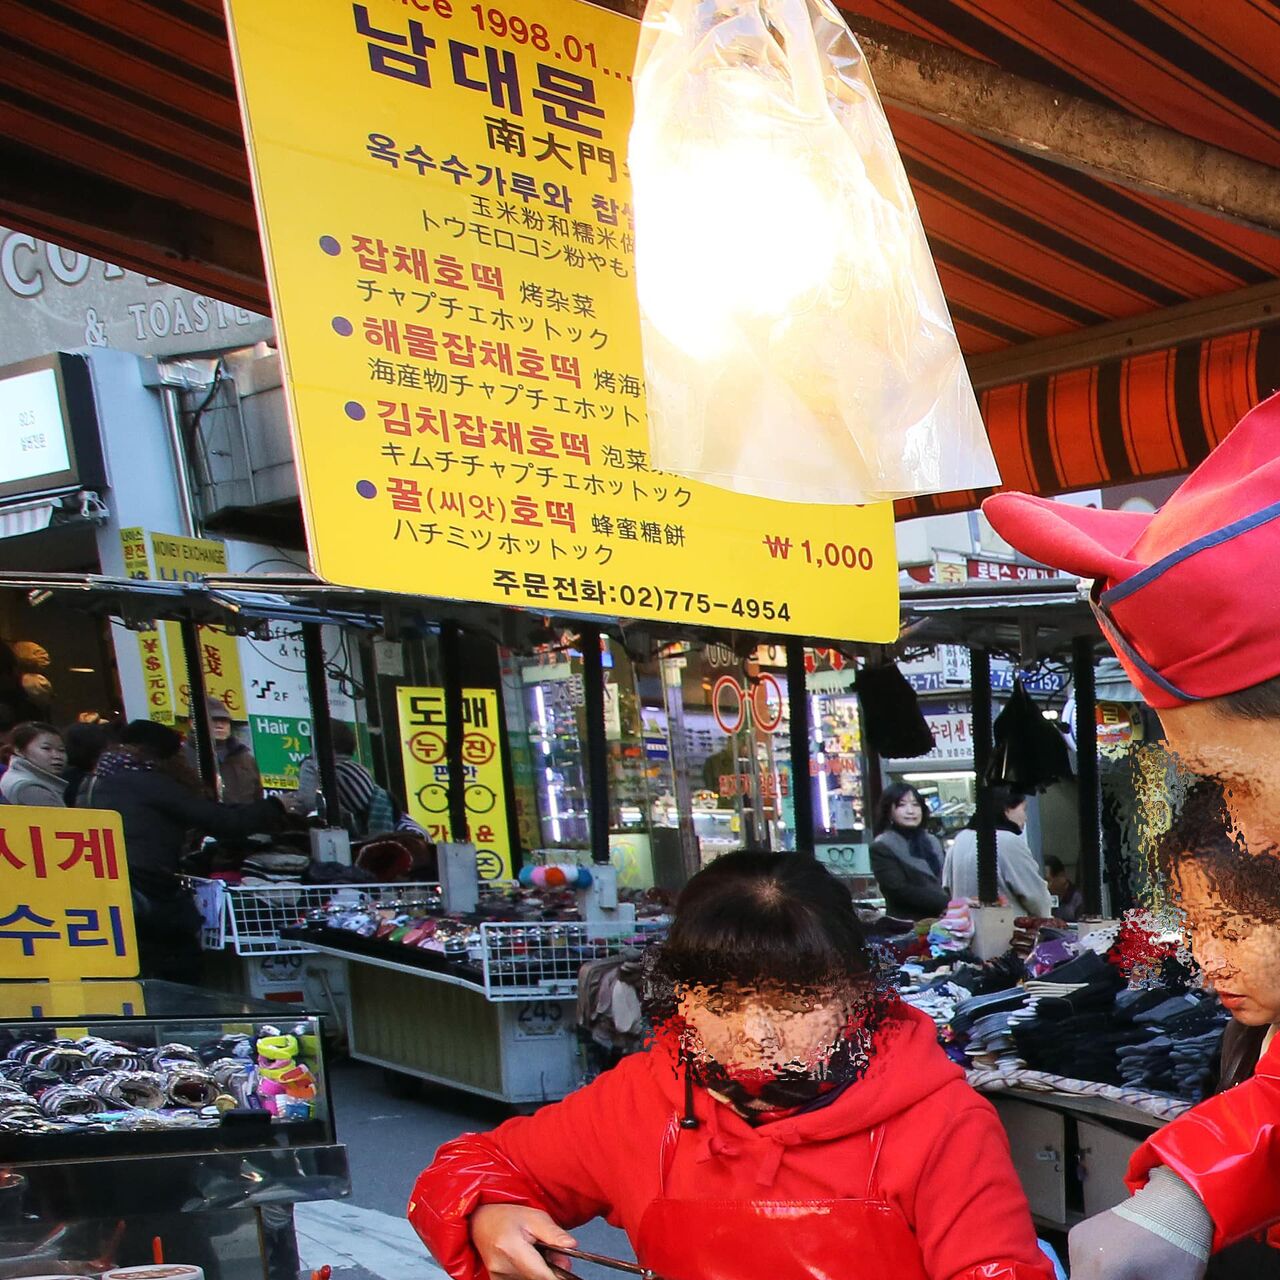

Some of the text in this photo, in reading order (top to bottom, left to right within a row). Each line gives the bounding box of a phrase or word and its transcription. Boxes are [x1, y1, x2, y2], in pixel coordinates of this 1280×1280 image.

[351, 3, 606, 140] 남대문
[366, 133, 572, 214] 옥수수가루와
[484, 115, 632, 184] 南大門
[422, 209, 635, 279] トウモロコシ粉やも
[351, 233, 597, 318] 잡채호떡 烤杂菜
[85, 306, 109, 348] &
[356, 279, 610, 351] チャプチェホットック
[361, 315, 583, 389] 해물잡채호떡
[376, 398, 592, 466] 김치잡채호떡
[182, 543, 226, 566] EXCHANGE
[386, 476, 577, 535] 꿀(씨앗)호떡
[591, 514, 686, 548] 蜂蜜糖餅
[801, 539, 874, 571] 1,000
[393, 521, 614, 567] ハチミツホットック
[492, 568, 792, 624] 주문전화:02)775-4954
[256, 718, 290, 736] Hair
[410, 696, 489, 728] 도매
[0, 826, 118, 880] 시계
[428, 824, 496, 844] 가운
[0, 906, 127, 957] 수리
